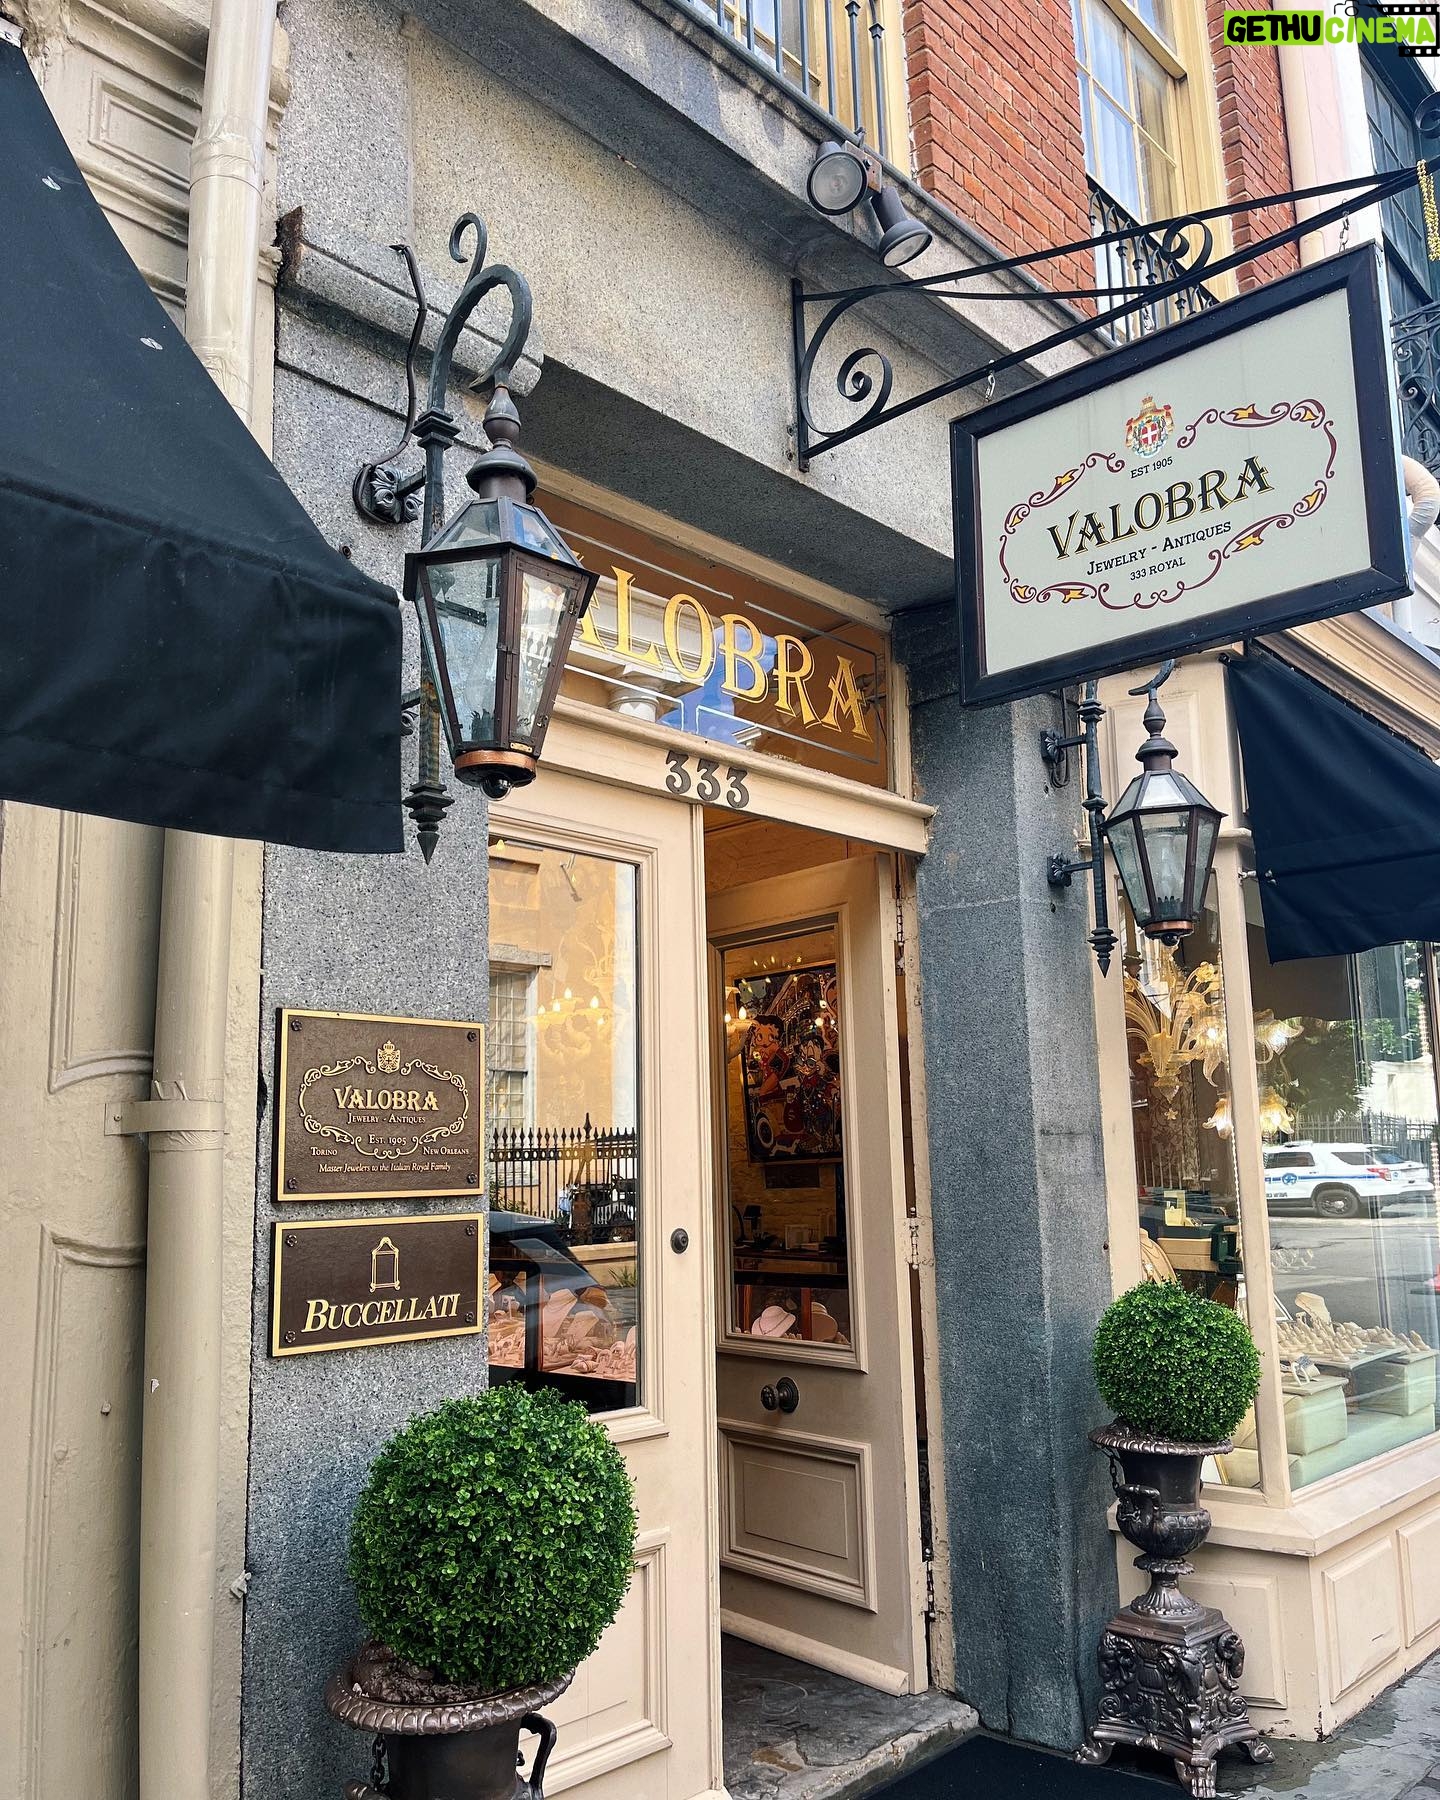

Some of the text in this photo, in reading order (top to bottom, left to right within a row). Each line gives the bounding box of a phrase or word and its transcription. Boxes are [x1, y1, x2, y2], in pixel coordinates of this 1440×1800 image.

[1130, 456, 1174, 479] EST 1905
[1047, 455, 1275, 560] VALOBRA
[1086, 548, 1147, 576] JEWELRY
[1162, 520, 1232, 552] ANTIQUES
[1129, 556, 1186, 581] 333 ROYAL
[665, 750, 750, 808] 333
[333, 1085, 439, 1111] VALOBRA
[347, 1113, 380, 1124] JEWELRY
[388, 1113, 426, 1124] ANTIQUES
[310, 1146, 338, 1156] TORINO
[368, 1134, 407, 1146] EST. 1905
[422, 1146, 470, 1155] NEW ORLEANS
[318, 1162, 451, 1173] Master Jewelers to the Italian Royal Family
[301, 1294, 461, 1333] BUCCELLATI
